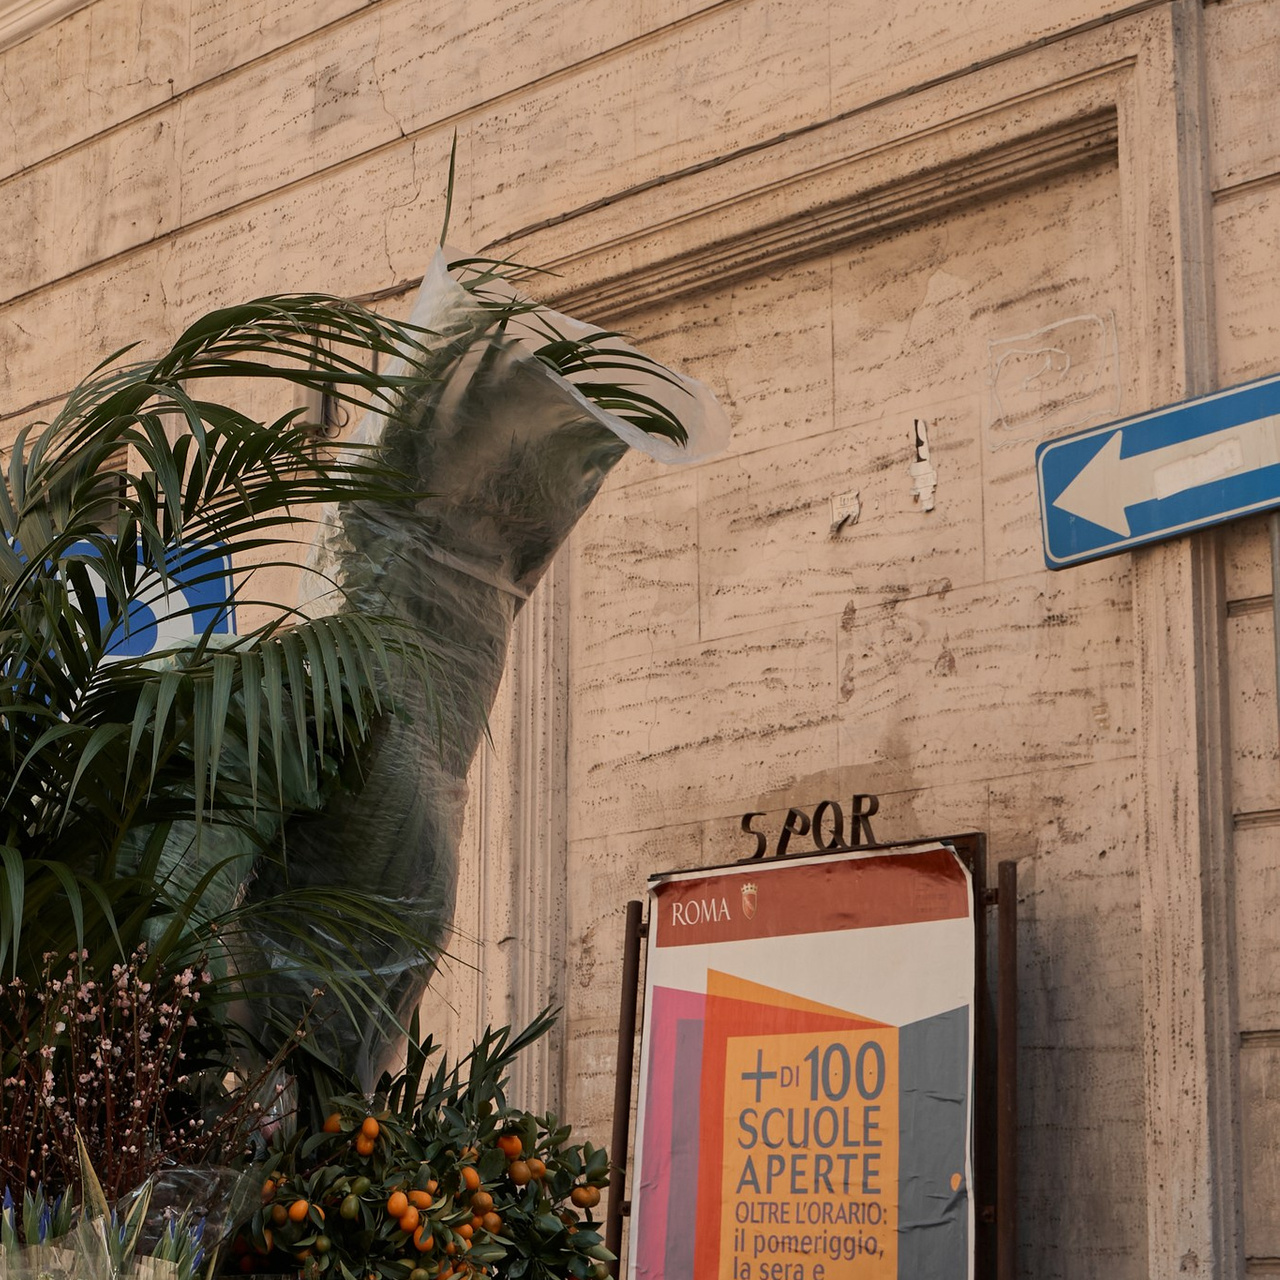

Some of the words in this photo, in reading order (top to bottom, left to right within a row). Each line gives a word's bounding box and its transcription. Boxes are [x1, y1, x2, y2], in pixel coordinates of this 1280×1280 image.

[737, 794, 879, 862] SPQR
[672, 897, 731, 926] ROMA
[780, 1065, 800, 1087] DI
[803, 1040, 885, 1101] 100
[737, 1105, 882, 1149] SCUOLE
[735, 1153, 881, 1194] APERTE
[735, 1201, 790, 1224] OLTRE
[796, 1201, 887, 1225] L'ORARIO:
[734, 1228, 745, 1252] il
[754, 1229, 884, 1261] pomeriggio,
[733, 1256, 751, 1280] la
